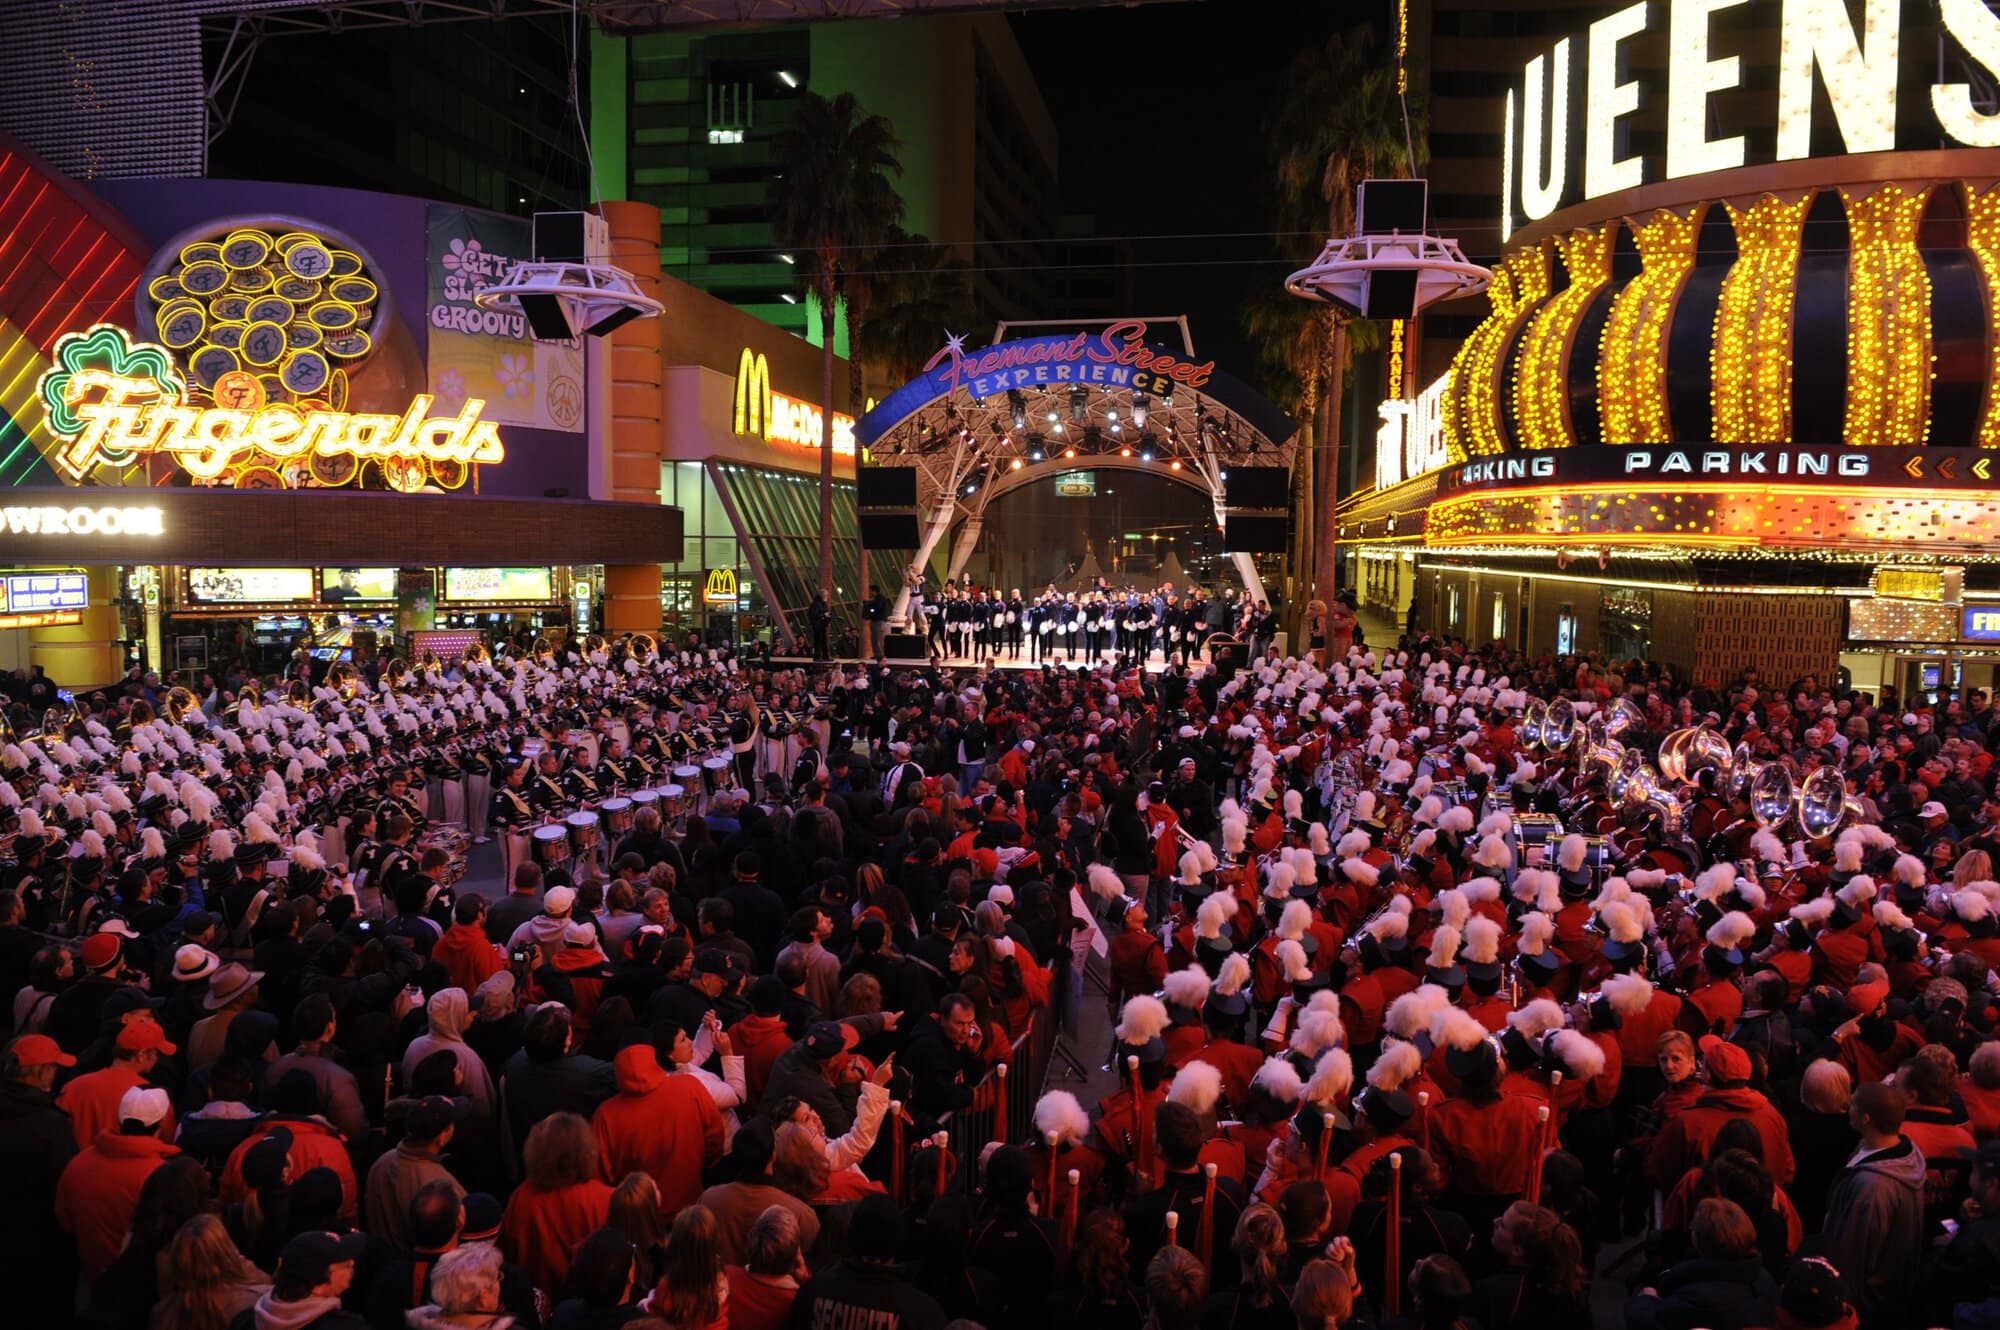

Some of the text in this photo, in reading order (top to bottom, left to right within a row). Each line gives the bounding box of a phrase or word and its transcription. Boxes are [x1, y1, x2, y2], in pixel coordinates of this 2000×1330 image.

[1501, 0, 2000, 244] UEEN
[461, 250, 508, 278] GET
[431, 304, 525, 340] GROOVY
[922, 320, 1216, 400] Fremont Street
[1390, 318, 1404, 399] NTRANCE
[973, 365, 1169, 396] EXPERIENCE
[1625, 451, 1871, 477] PARKING
[0, 506, 164, 536] WROOM
[810, 1295, 902, 1330] SECURITY
